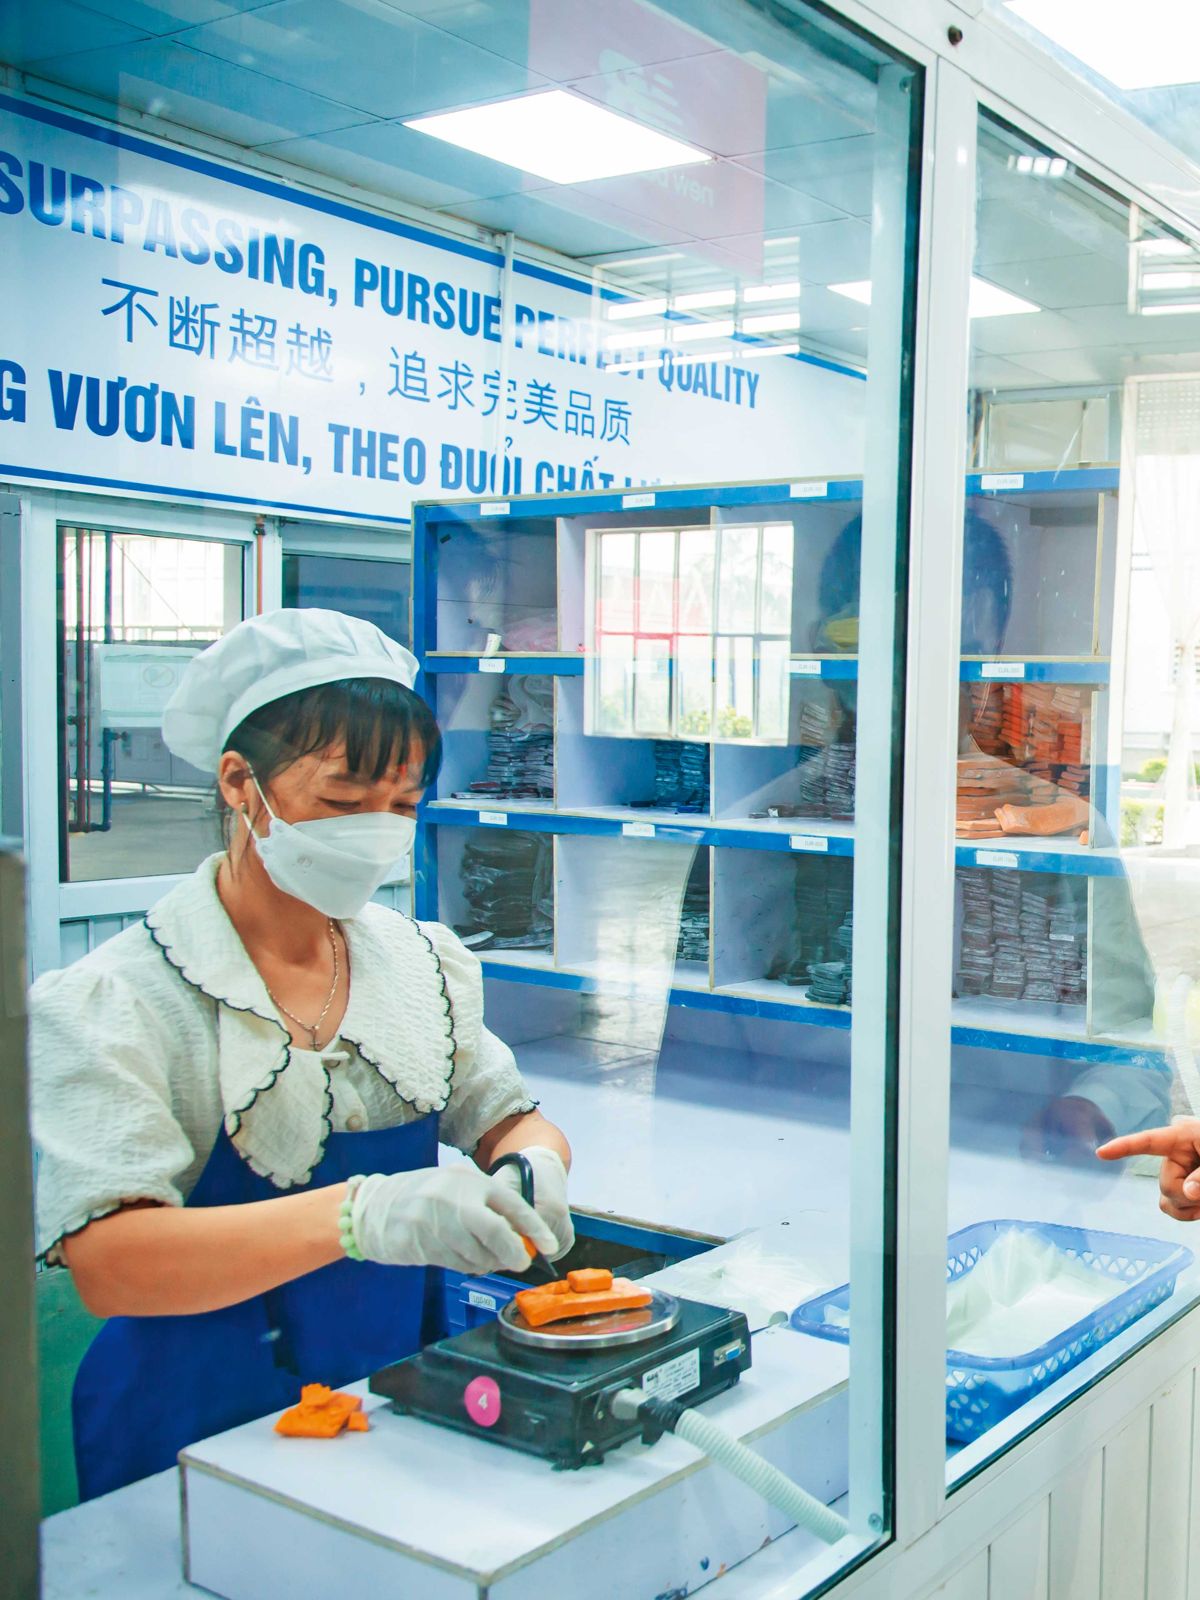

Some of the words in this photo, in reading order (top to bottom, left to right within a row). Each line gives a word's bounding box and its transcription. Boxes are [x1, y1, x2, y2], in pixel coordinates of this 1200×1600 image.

[0, 150, 338, 307] SURPASSING,
[354, 257, 502, 344] PURSUE
[657, 348, 760, 409] QUALITY
[48, 369, 195, 450] VƯƠN
[214, 396, 312, 475] LÊN,
[328, 422, 427, 486] THEO
[478, 1392, 488, 1410] 4
